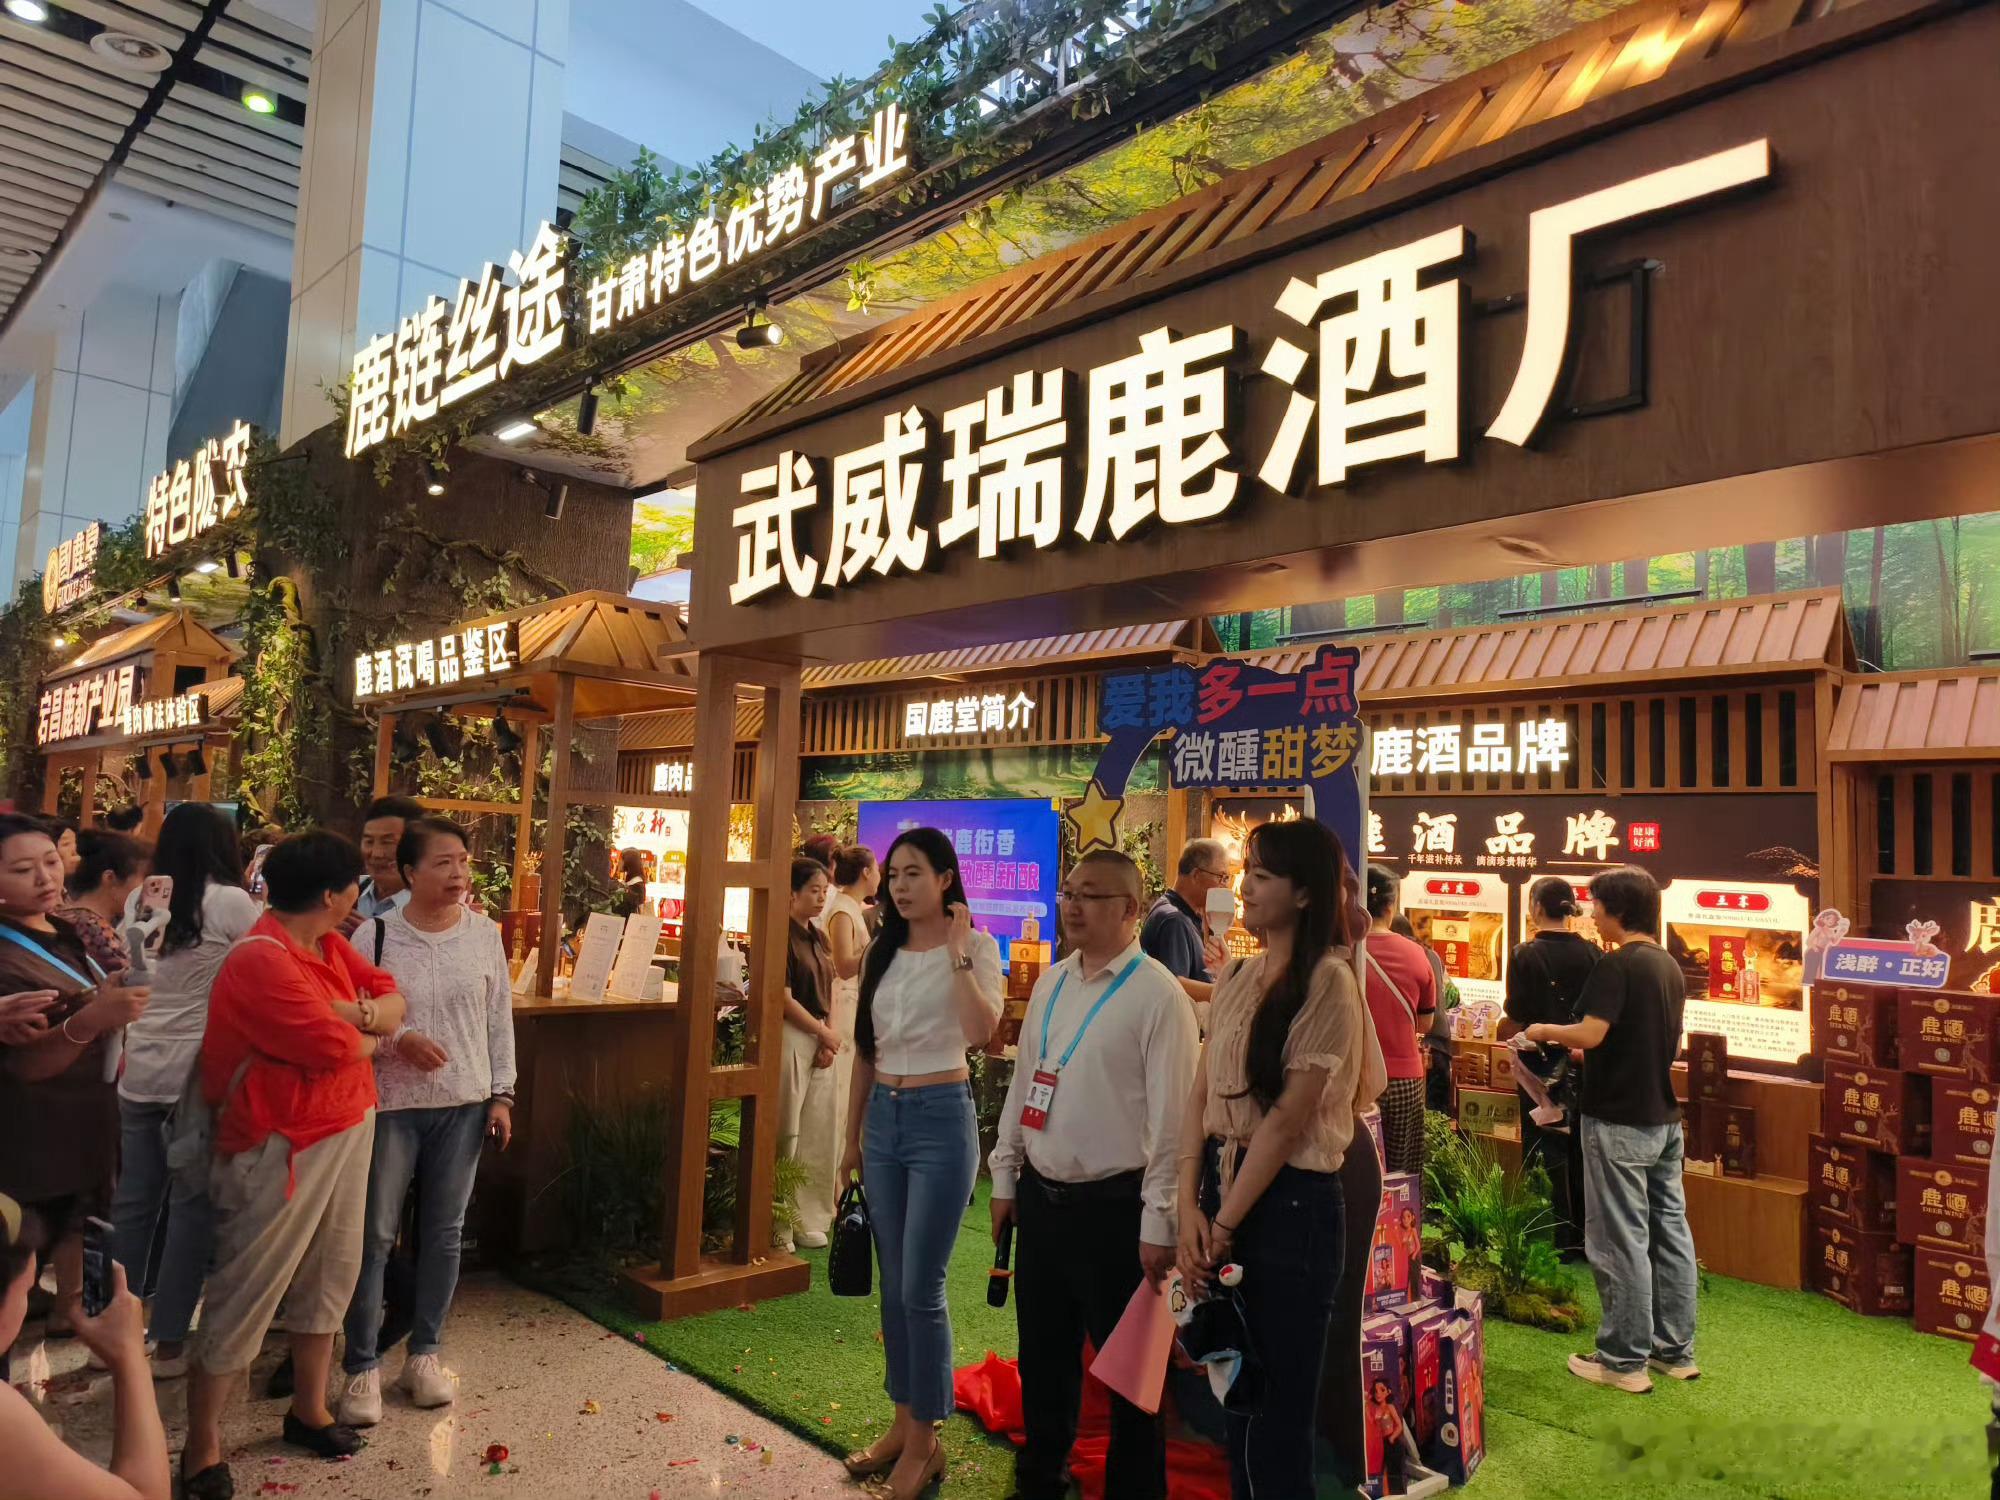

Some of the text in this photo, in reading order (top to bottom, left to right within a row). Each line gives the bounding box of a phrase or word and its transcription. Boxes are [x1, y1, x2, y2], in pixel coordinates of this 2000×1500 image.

[587, 103, 908, 334] 甘肃特色优势产业
[731, 137, 1770, 606] 武威瑞鹿酒厂
[356, 621, 511, 697] 鹿酒试喝品鉴区
[905, 690, 1036, 737] 国鹿堂简介
[1104, 652, 1353, 729] 爱我多一点
[1174, 722, 1357, 782] 微醺甜梦
[1371, 718, 1569, 776] 鹿酒品牌
[1920, 1187, 1969, 1212] 鹿酒
[1939, 1279, 1989, 1305] 鹿酒
